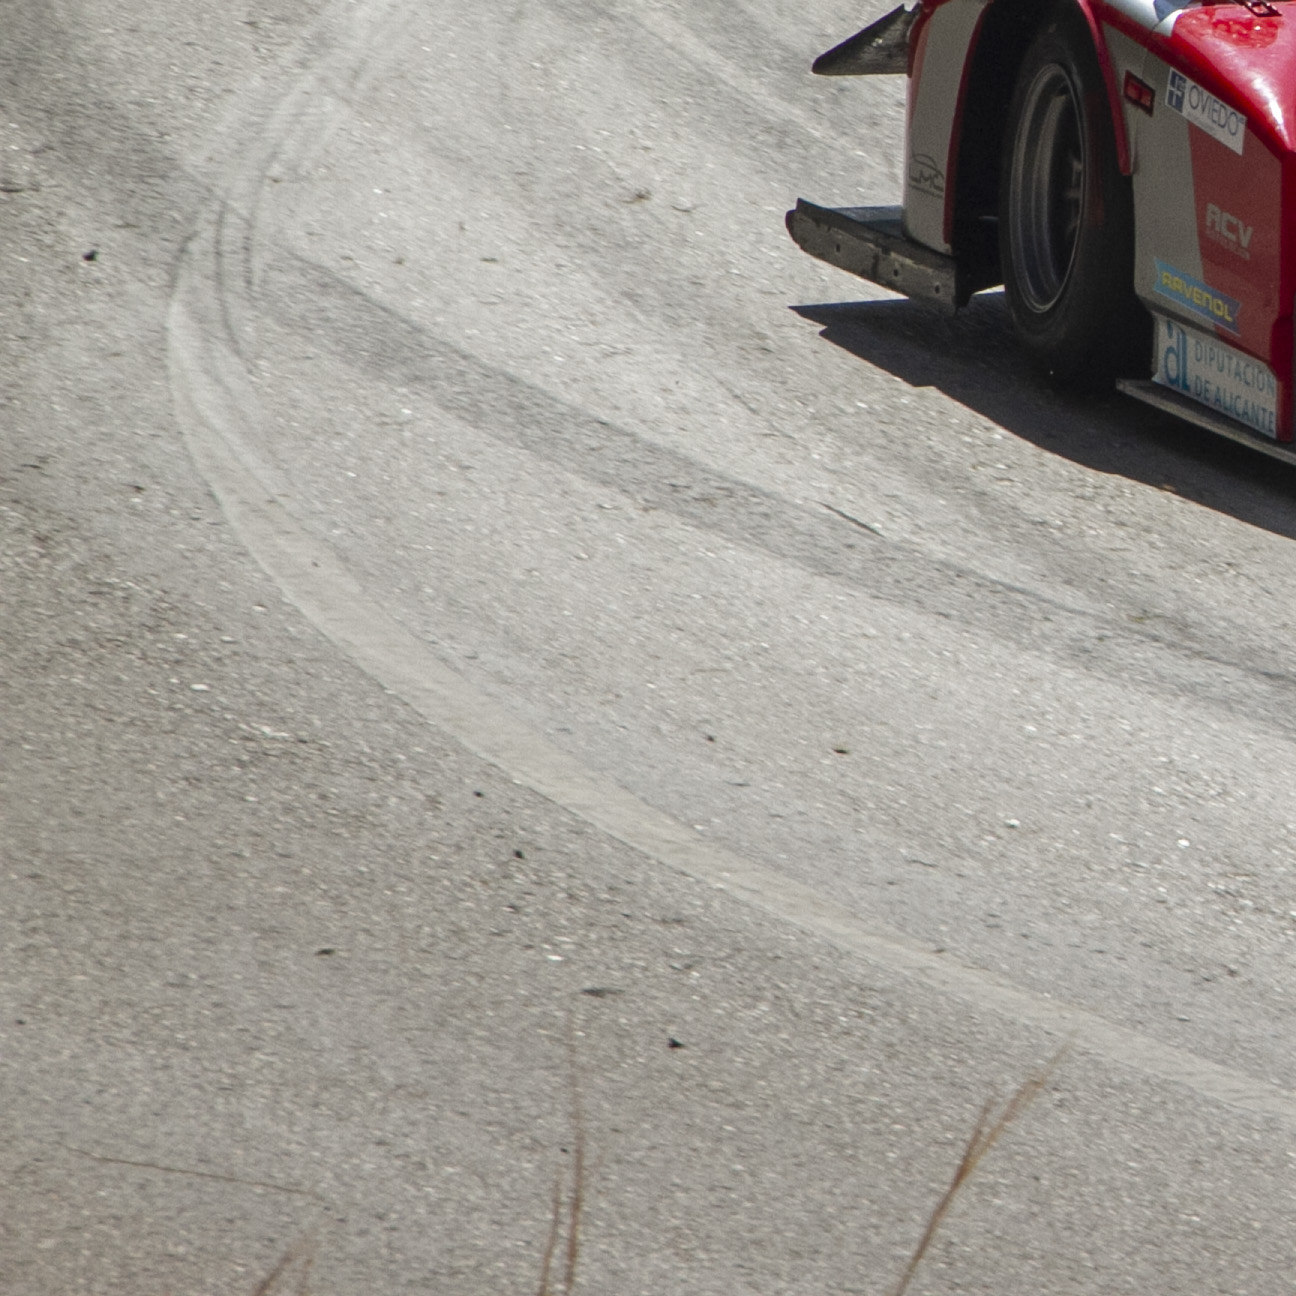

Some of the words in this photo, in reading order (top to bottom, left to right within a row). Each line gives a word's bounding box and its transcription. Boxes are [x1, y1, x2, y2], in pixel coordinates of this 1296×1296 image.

[1189, 85, 1239, 136] OVIEDO
[1162, 271, 1233, 322] RAVENOL
[1195, 374, 1211, 402] DE
[1214, 384, 1276, 434] ALICANTE
